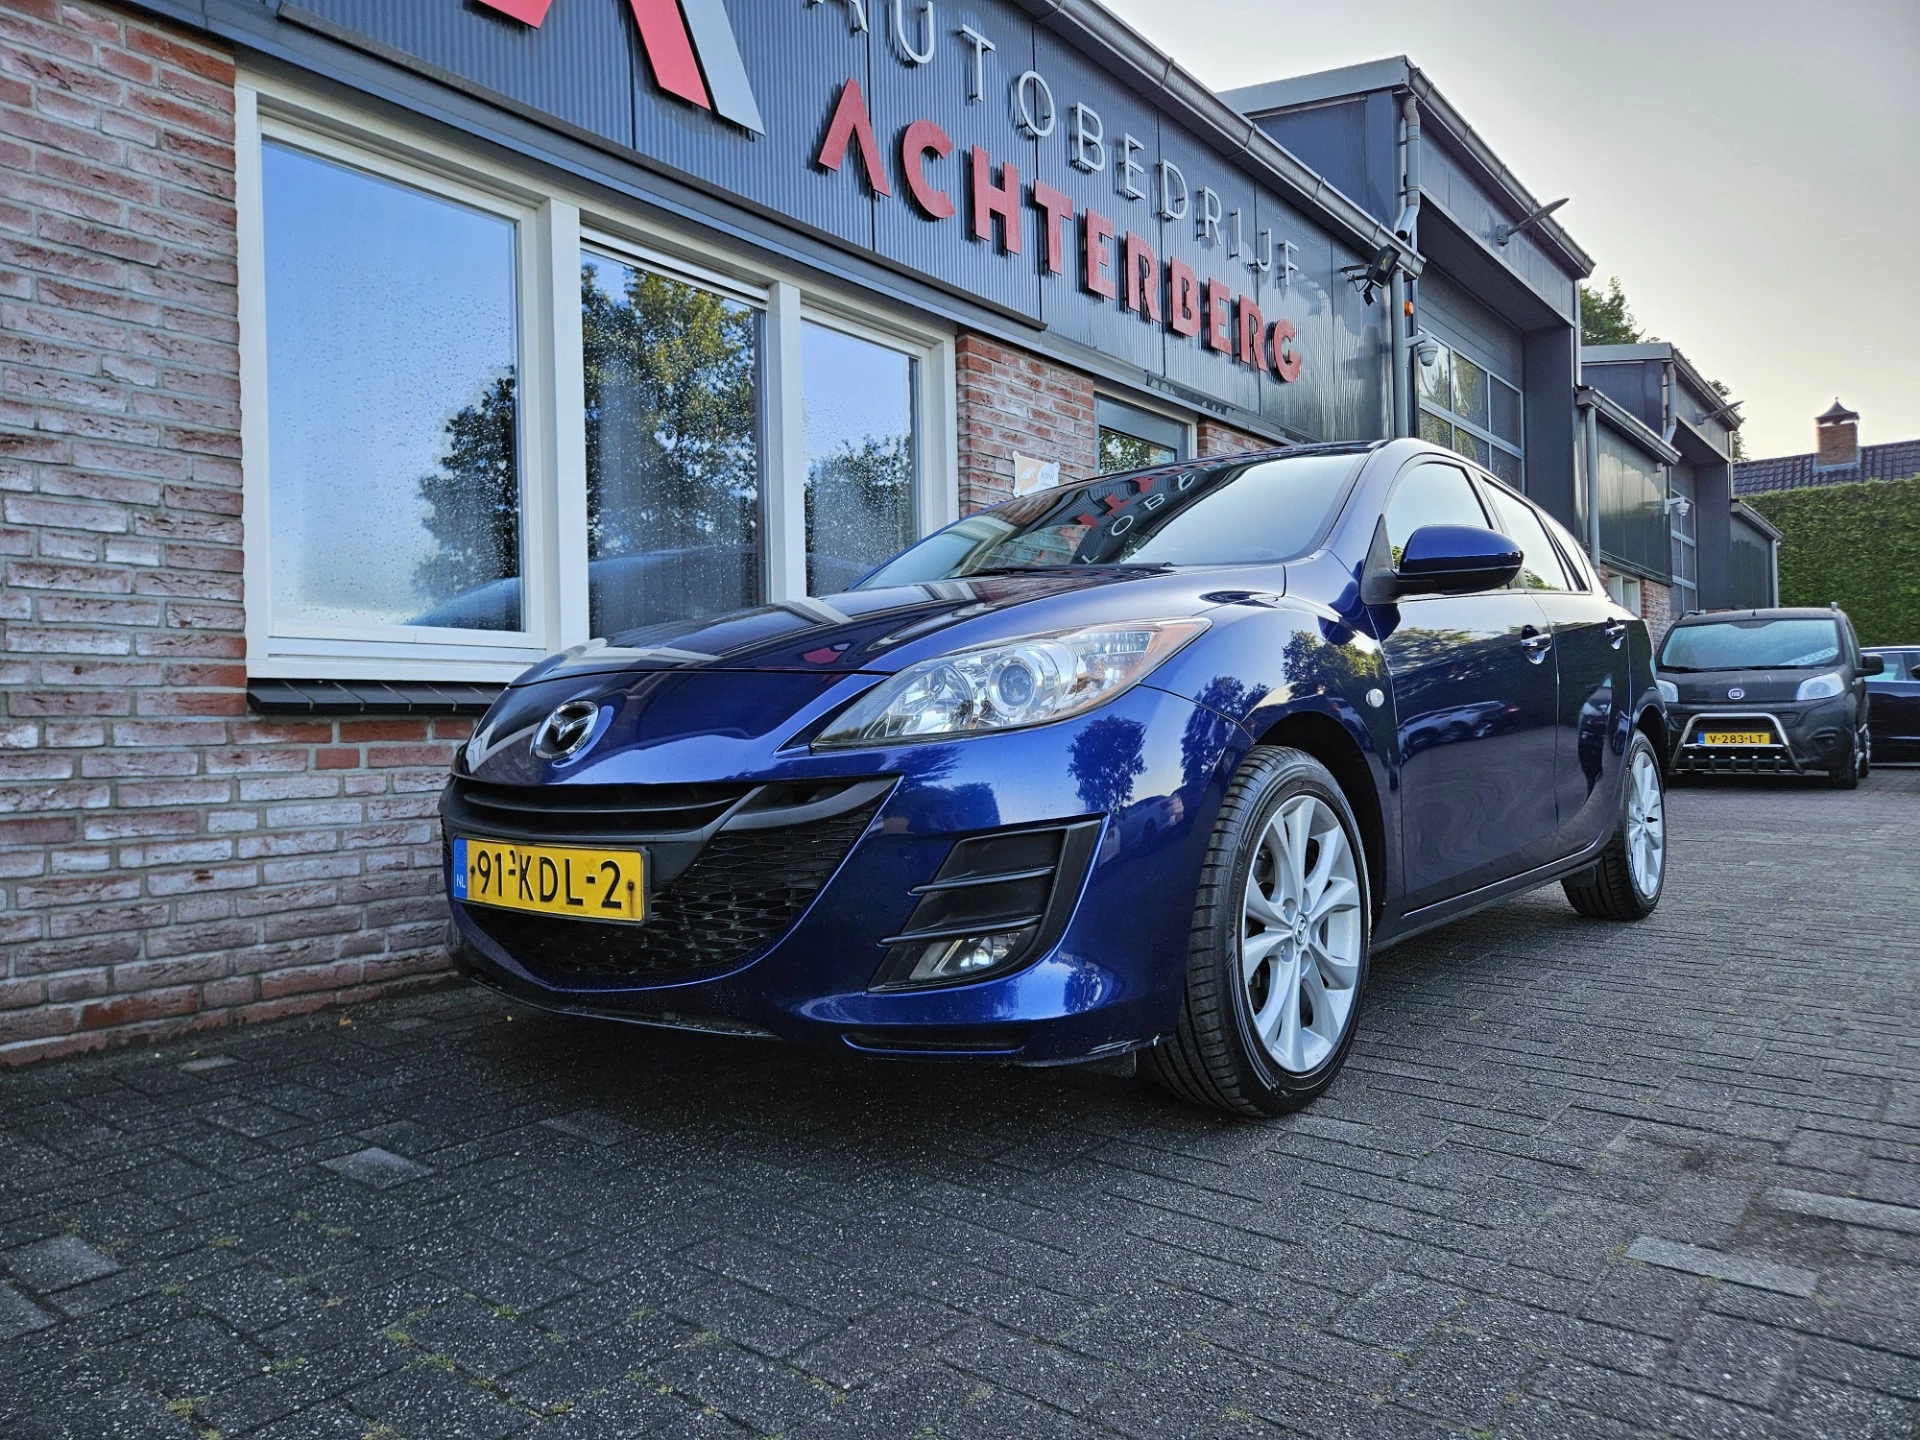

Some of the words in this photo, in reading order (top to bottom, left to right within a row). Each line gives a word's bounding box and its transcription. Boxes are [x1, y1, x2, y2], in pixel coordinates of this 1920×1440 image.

[818, 77, 1301, 383] ACHTERBERG
[1709, 734, 1763, 744] V-283-LT
[456, 874, 466, 888] NL
[477, 850, 622, 909] 91-KDL-2
